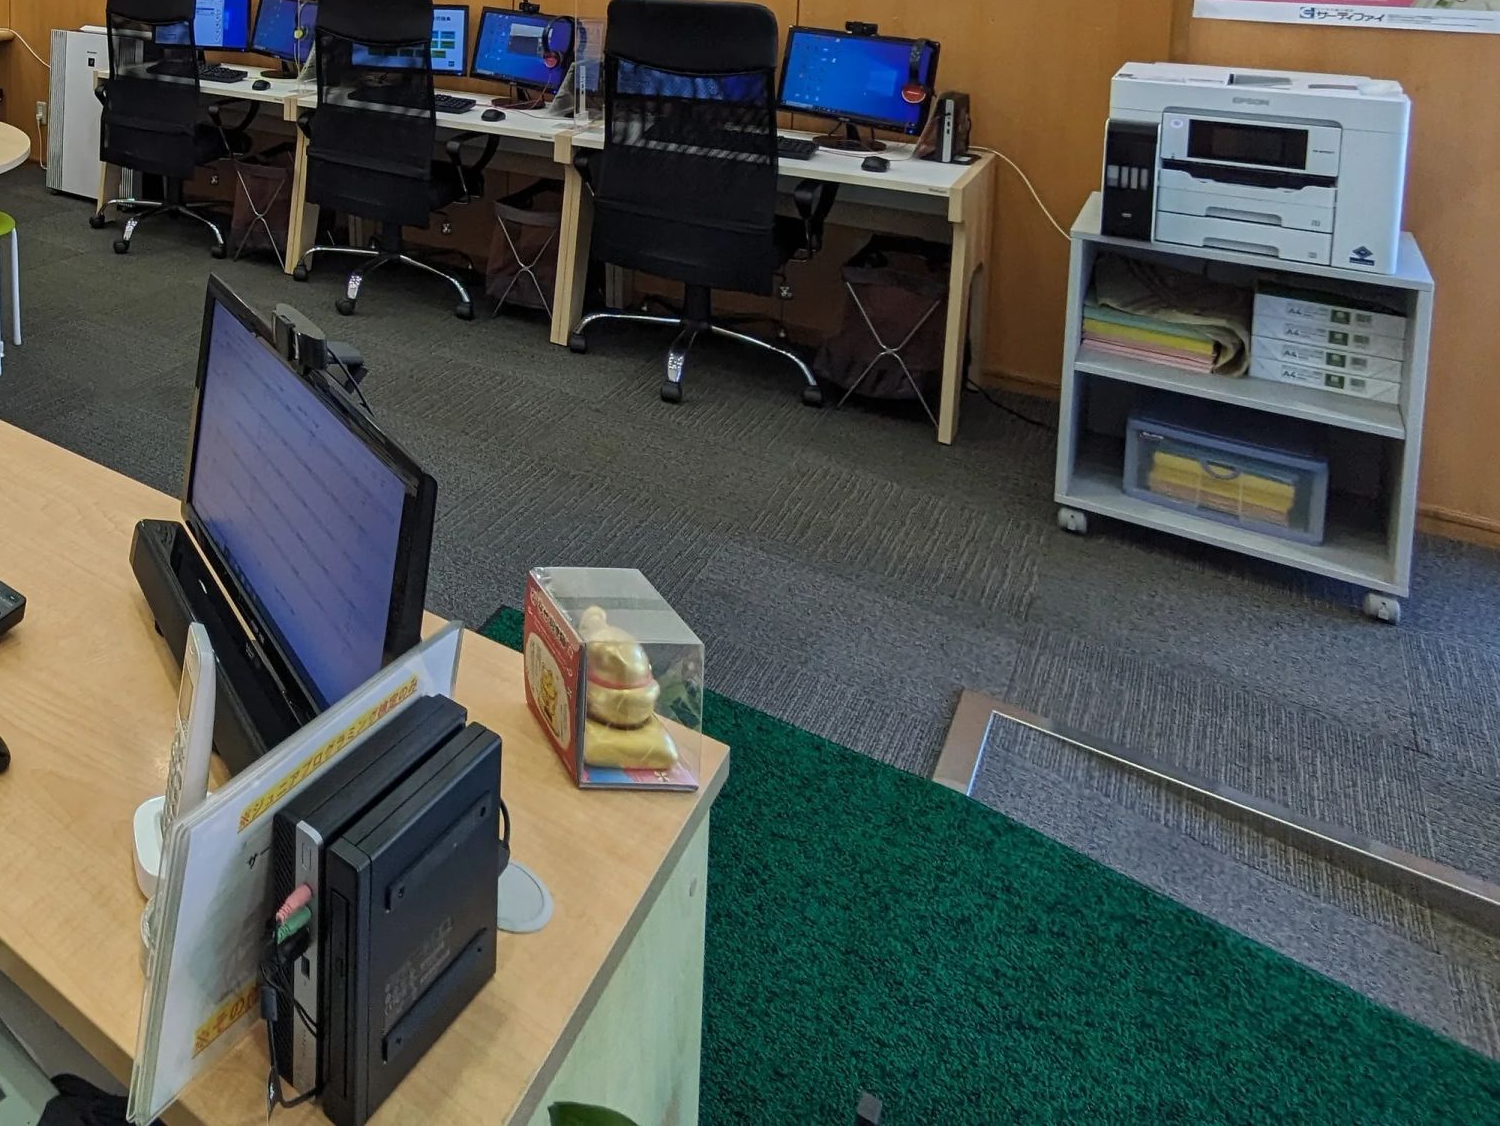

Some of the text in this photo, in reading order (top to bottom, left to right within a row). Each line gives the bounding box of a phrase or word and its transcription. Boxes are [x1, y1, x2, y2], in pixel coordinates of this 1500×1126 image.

[1316, 10, 1386, 22] サーティファイ
[1232, 97, 1270, 106] EPSON
